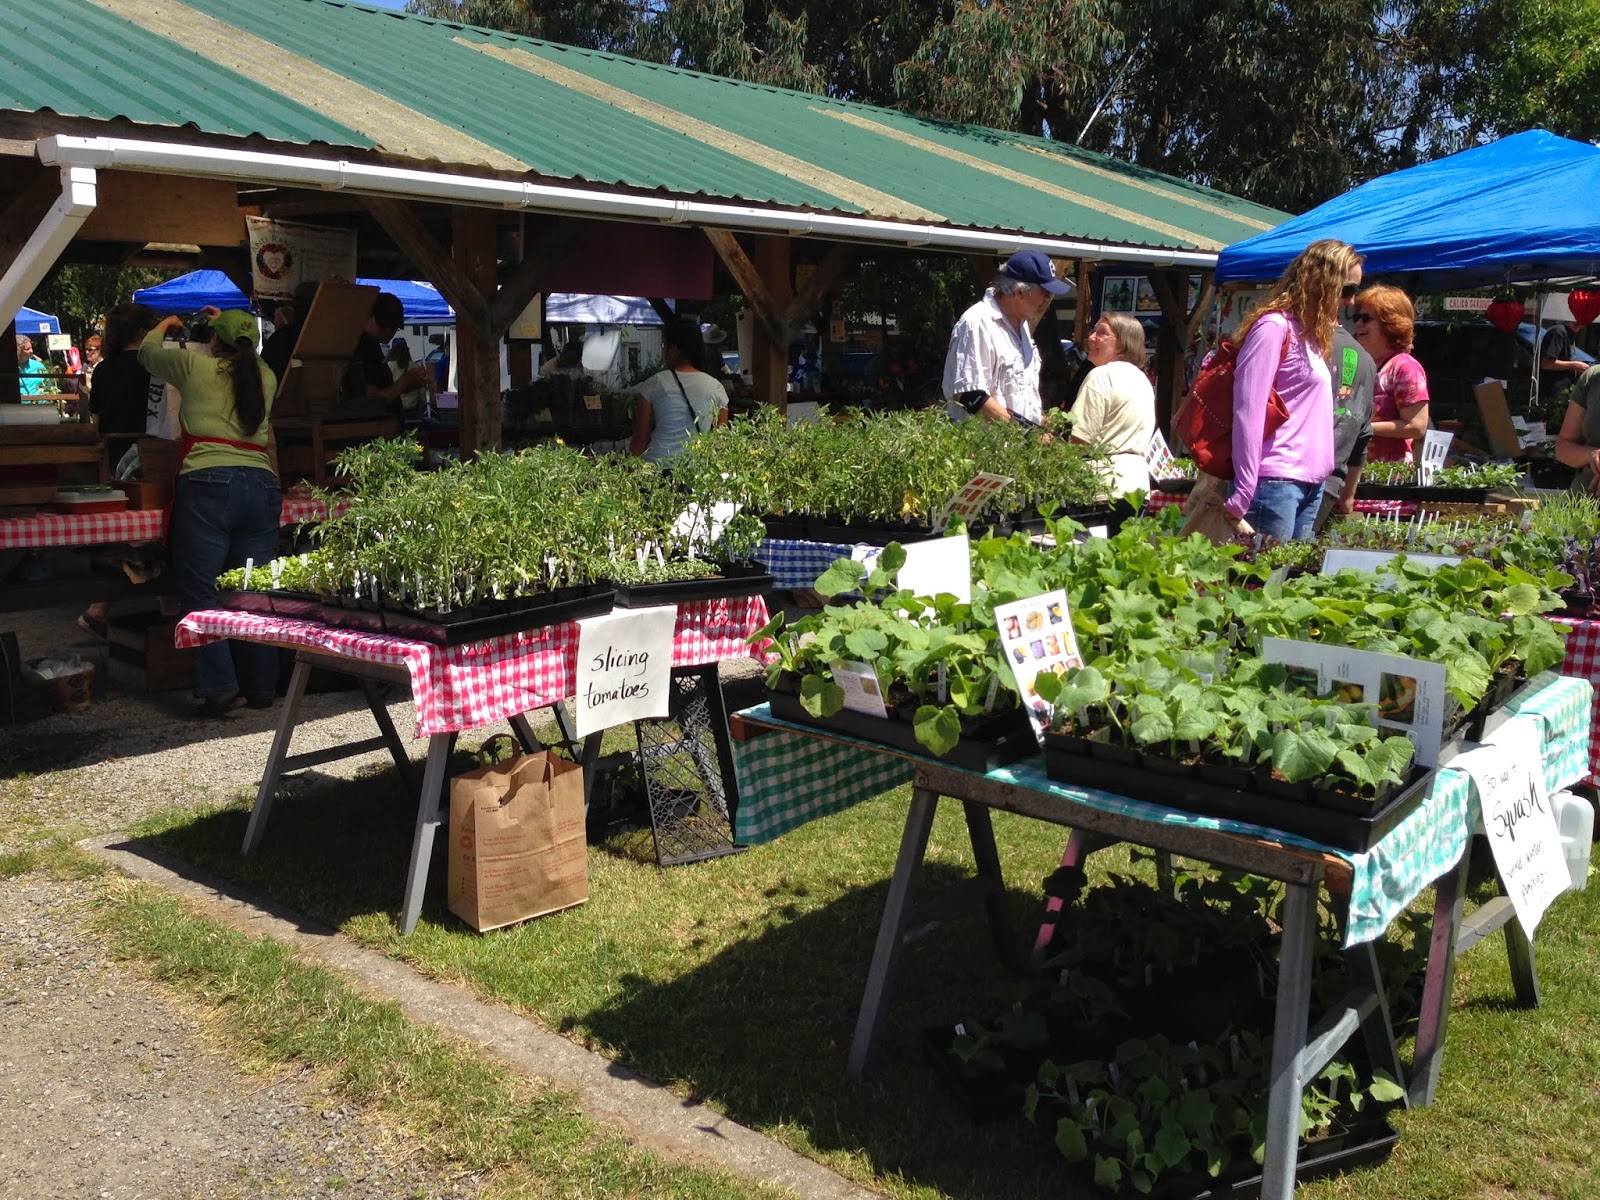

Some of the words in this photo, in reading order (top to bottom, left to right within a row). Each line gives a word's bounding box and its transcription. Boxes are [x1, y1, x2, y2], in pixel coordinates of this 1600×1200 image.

[591, 646, 649, 677] slicing
[583, 678, 649, 709] tomatoes
[1493, 771, 1545, 842] Squash
